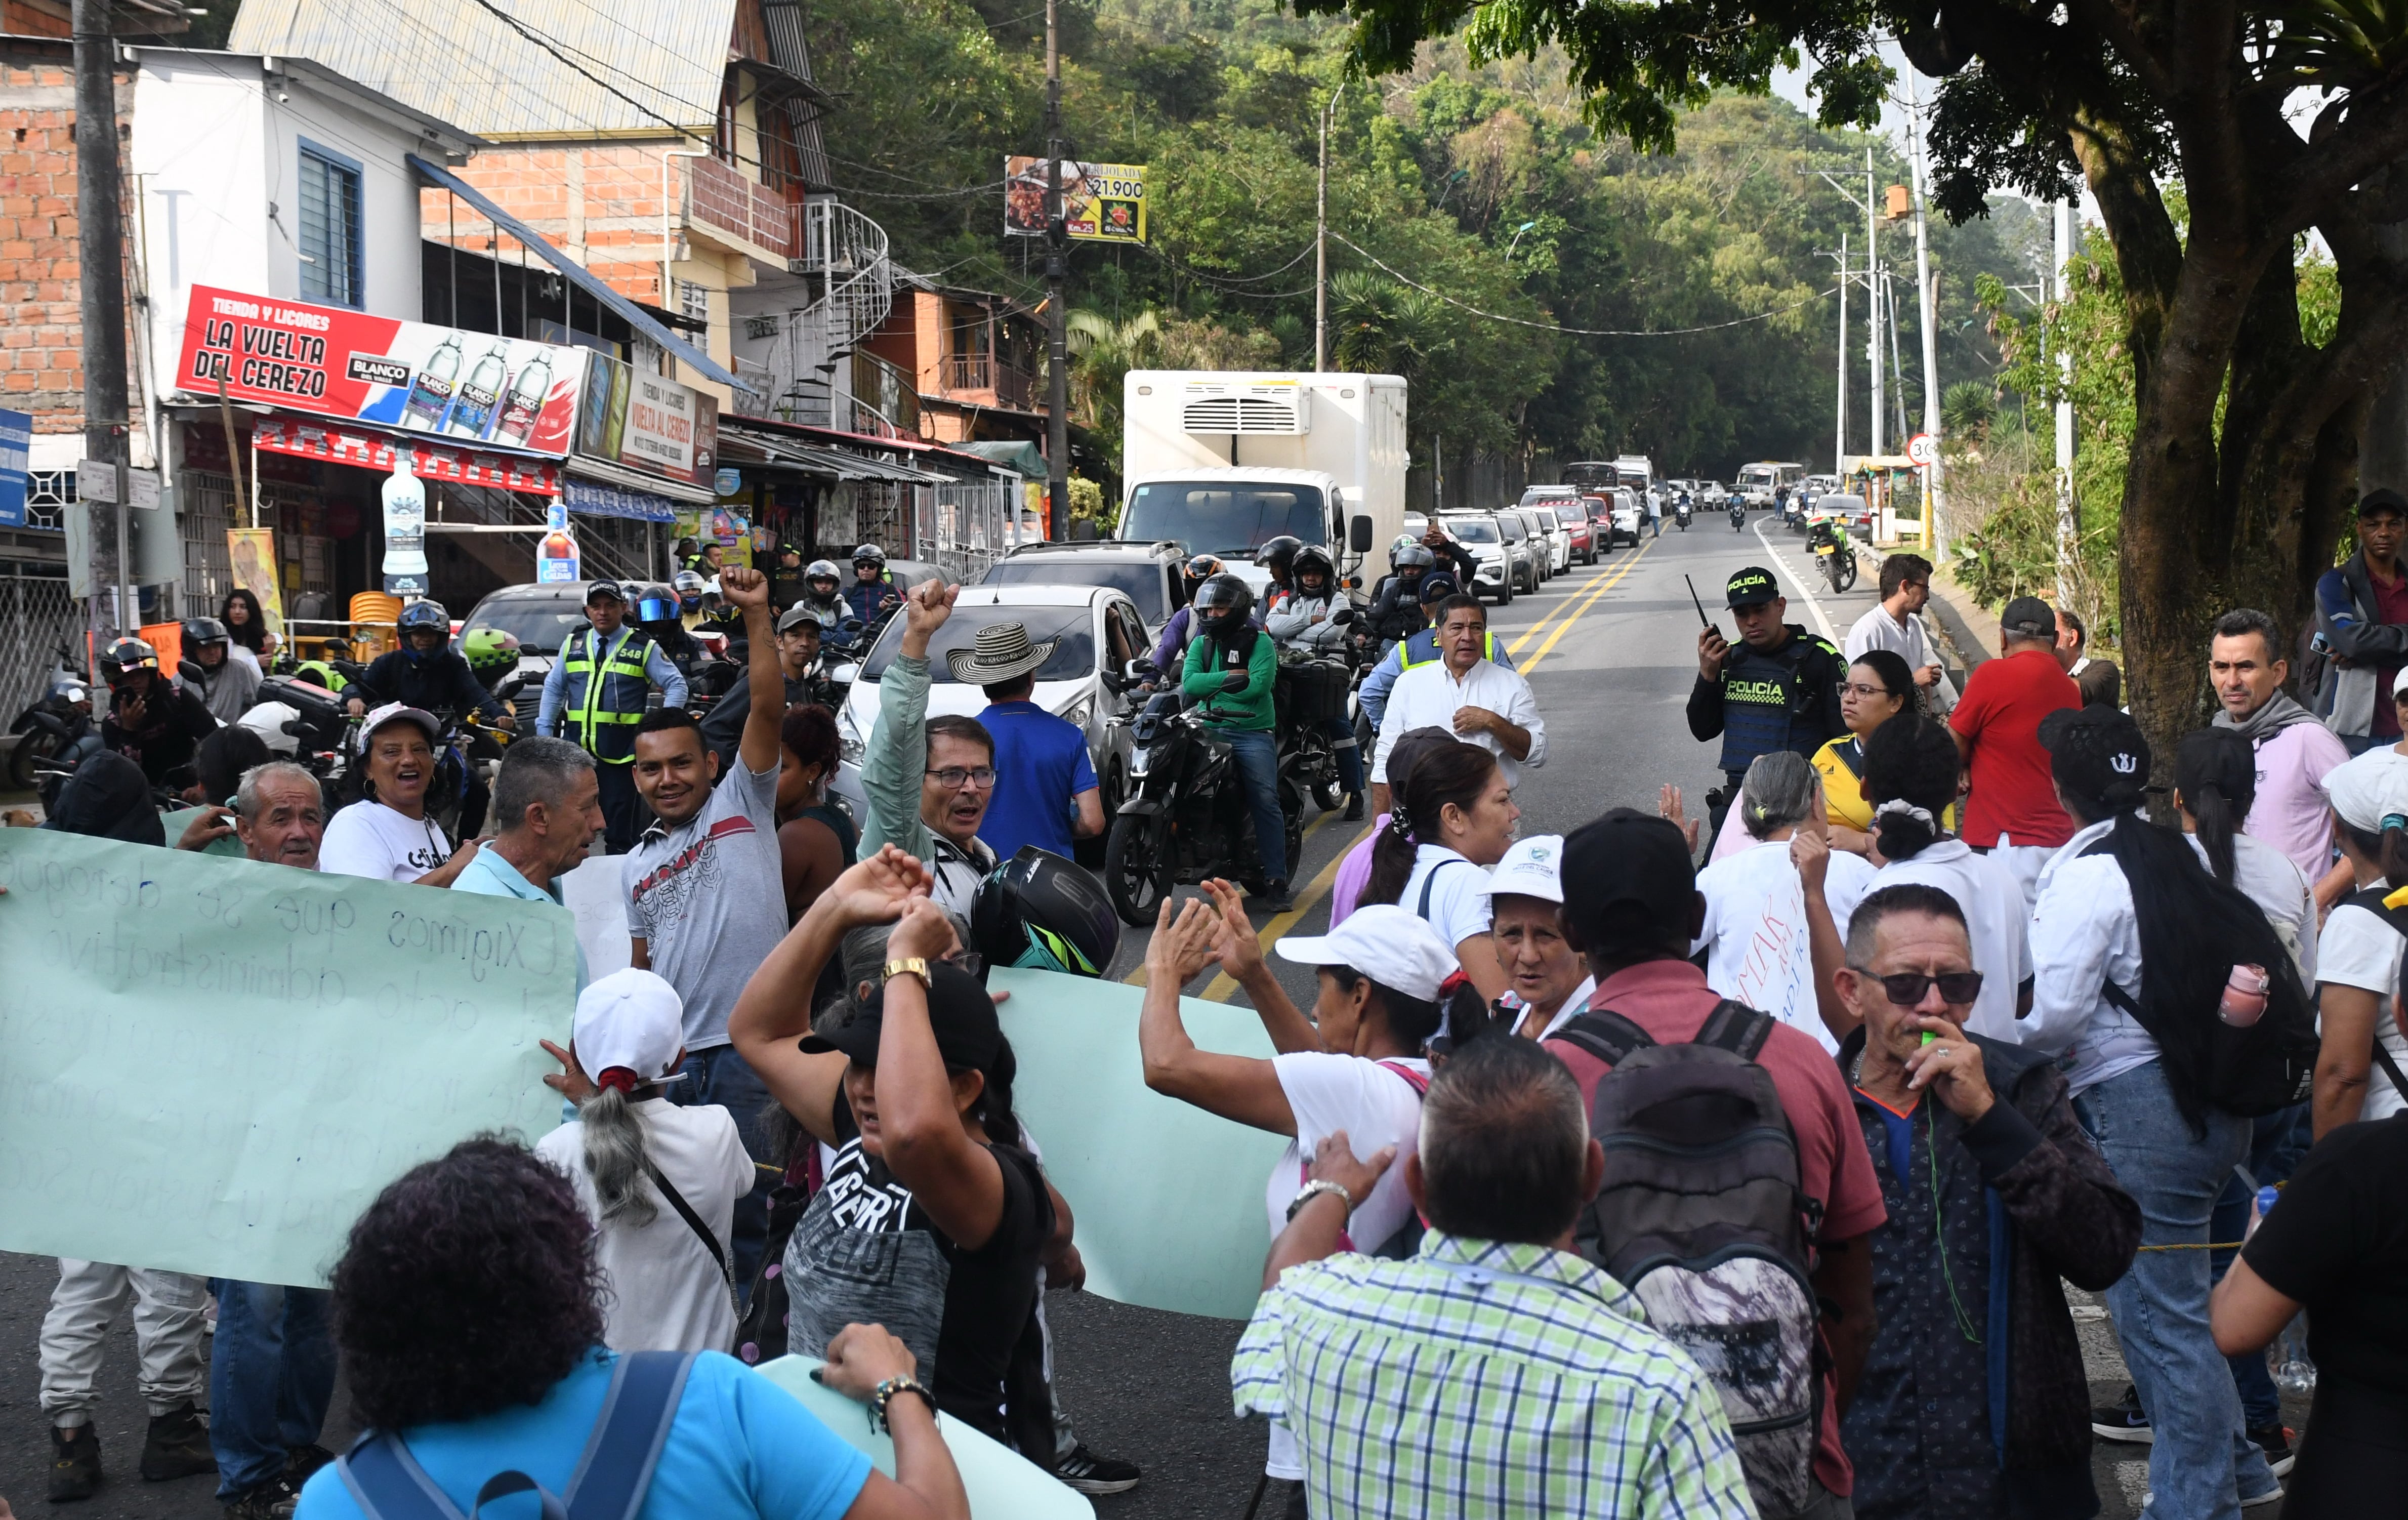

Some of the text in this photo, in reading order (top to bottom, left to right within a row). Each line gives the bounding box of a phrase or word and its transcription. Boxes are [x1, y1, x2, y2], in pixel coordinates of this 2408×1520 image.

[1068, 223, 1093, 234] Km.25
[212, 297, 330, 332] TIENDA Y LICORES
[204, 319, 325, 365] LA VUELTA
[193, 350, 234, 382] DEL
[241, 358, 325, 397] CEREZO
[353, 360, 405, 379] BLANCO
[419, 374, 451, 394] BLANCO
[464, 384, 495, 404] BLANCO
[643, 382, 660, 402] TIENDA
[661, 389, 665, 403] Y
[457, 395, 490, 417] FIESTA
[509, 391, 540, 410] BLANCO
[632, 401, 691, 444] VUELTA AL CEREZO
[1727, 574, 1767, 593] POLICÍA
[619, 648, 642, 659] 548
[1727, 679, 1782, 696] POLICÍA
